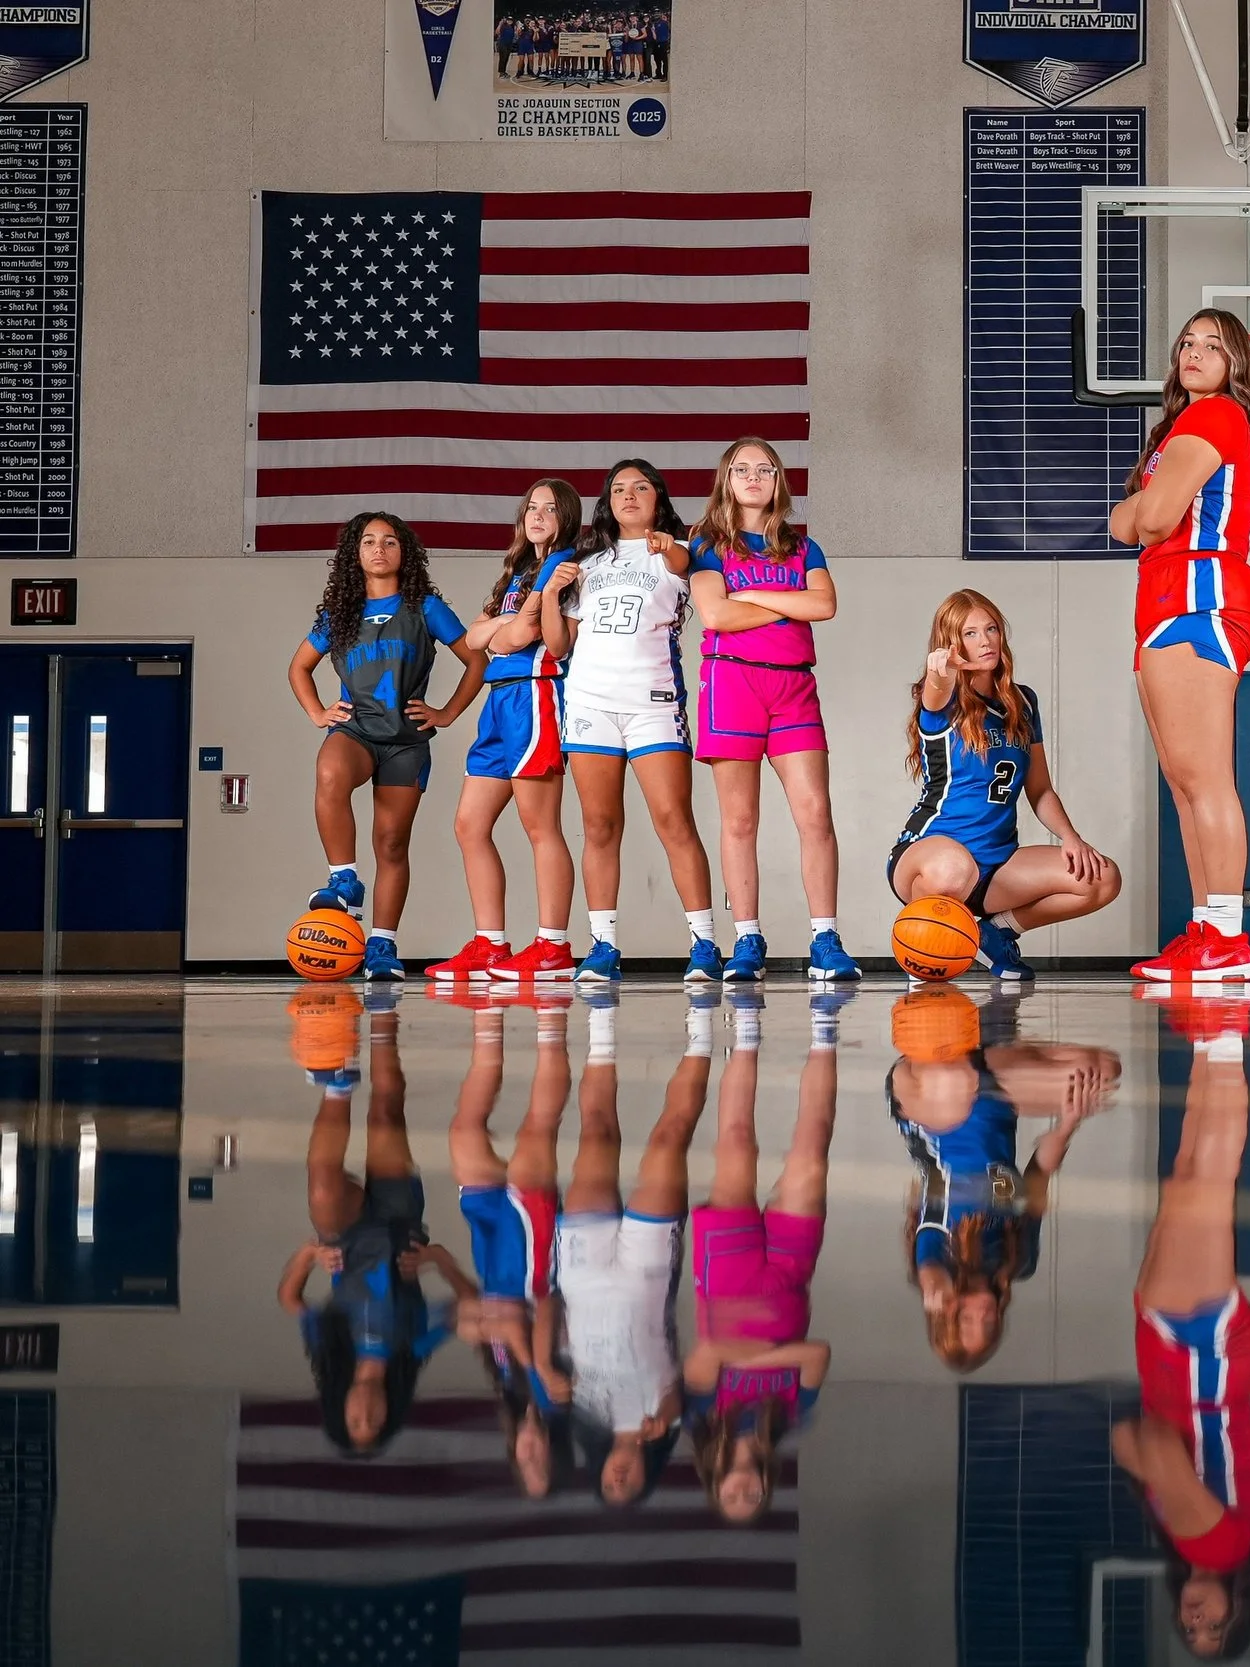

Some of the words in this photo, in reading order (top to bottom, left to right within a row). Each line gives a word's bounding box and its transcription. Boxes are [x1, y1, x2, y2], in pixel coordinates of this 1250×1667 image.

[0, 9, 77, 22] HAMPIONS
[977, 13, 1056, 28] INDIVIDUAL
[1060, 14, 1134, 28] CHAMPION
[497, 98, 519, 108] SAC
[523, 98, 571, 109] JOAQUIN
[574, 98, 620, 108] SECTION
[498, 111, 517, 124] D2
[522, 111, 620, 124] CHAMPIONS
[632, 111, 661, 123] 2025
[987, 118, 1008, 126] Name
[1055, 119, 1075, 127] Sport
[57, 128, 73, 137] 1962
[497, 126, 533, 137] GIRLS
[537, 126, 620, 137] BASKETBALL
[977, 132, 995, 141] Dave
[995, 132, 1018, 140] Porath
[1030, 132, 1047, 142] Boys
[1048, 132, 1065, 140] Track
[1072, 132, 1088, 140] Shot
[1089, 132, 1101, 140] Put
[1116, 132, 1131, 141] 1978
[25, 142, 42, 150] HWT
[57, 143, 73, 152] 1965
[977, 147, 995, 155] Dave
[995, 147, 1018, 155] Porath
[1033, 147, 1050, 157] Boys
[1051, 147, 1069, 155] Track
[1075, 146, 1098, 155] Discus
[1116, 147, 1131, 155] 1978
[27, 159, 39, 167] 145
[57, 159, 72, 167] 1973
[1031, 161, 1048, 171] Boys
[1049, 161, 1082, 171] Wrestling
[14, 172, 37, 180] Discus
[56, 172, 72, 181] 1976
[14, 187, 36, 195] Discus
[55, 188, 71, 196] 1977
[27, 202, 37, 211] 165
[55, 203, 71, 211] 1977
[54, 232, 70, 240] 1978
[13, 244, 35, 252] Discus
[54, 244, 70, 253] 1978
[18, 259, 43, 267] Hurdles
[53, 261, 69, 269] 1979
[25, 275, 36, 283] 145
[53, 275, 69, 283] 1979
[25, 288, 35, 297] 98
[53, 288, 69, 297] 1982
[8, 303, 25, 311] Shot
[26, 303, 38, 311] Put
[52, 303, 68, 312] 1984
[6, 318, 23, 326] Shot
[24, 318, 36, 326] Put
[52, 318, 68, 327] 1985
[52, 333, 68, 342] 1986
[7, 348, 24, 356] Shot
[25, 348, 36, 356] Put
[51, 348, 68, 357] 1989
[23, 361, 33, 370] 98
[51, 361, 67, 371] 1989
[22, 393, 33, 401] 103
[51, 393, 65, 401] 1991
[5, 405, 22, 413] Shot
[50, 407, 66, 415] 1992
[5, 422, 22, 431] Shot
[23, 423, 35, 431] Put
[50, 424, 65, 432] 1993
[8, 440, 37, 449] Country
[49, 439, 66, 449] 1998
[2, 456, 19, 466] High
[19, 456, 38, 466] Jump
[49, 456, 66, 465] 1998
[5, 472, 21, 480] Shot
[22, 473, 34, 481] Put
[13, 506, 36, 514] Hurdles
[588, 569, 660, 593] FALCONS
[24, 589, 61, 613] EXIT
[592, 595, 644, 634] 23
[373, 669, 397, 711] 4
[987, 760, 1017, 805] 2
[298, 927, 347, 950] Wilson
[298, 953, 337, 969] NCAA
[904, 956, 948, 976] NCAA
